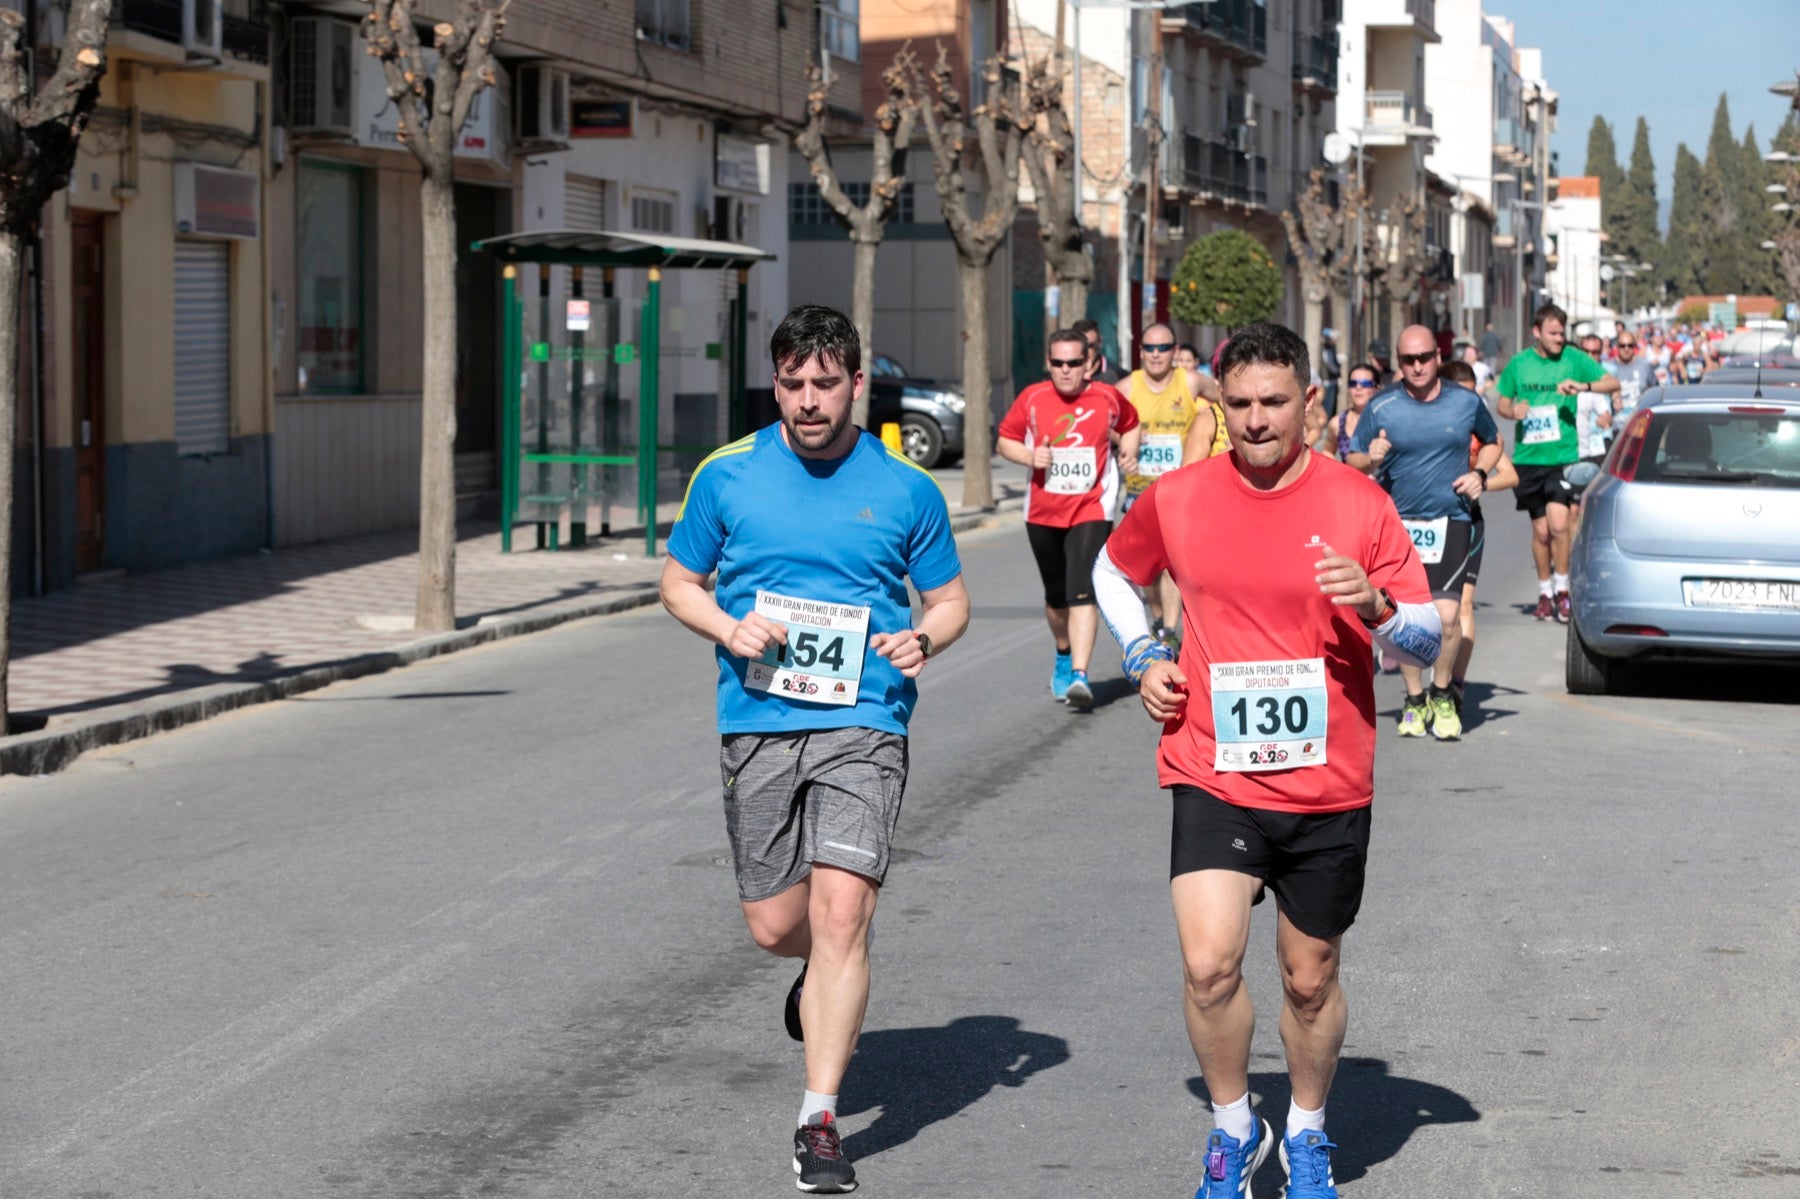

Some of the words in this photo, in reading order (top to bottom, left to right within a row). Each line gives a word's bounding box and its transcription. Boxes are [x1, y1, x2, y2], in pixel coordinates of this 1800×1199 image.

[1050, 462, 1091, 477] 3040
[1407, 528, 1436, 547] 29
[1709, 581, 1757, 600] 7023
[783, 599, 802, 611] GRAN
[803, 602, 829, 615] PREMIO
[829, 606, 839, 616] DE
[840, 607, 862, 619] FONDO
[1235, 665, 1255, 676] GRAN
[1256, 665, 1283, 676] PREMIO
[1285, 664, 1294, 675] DE
[1231, 695, 1309, 736] 130
